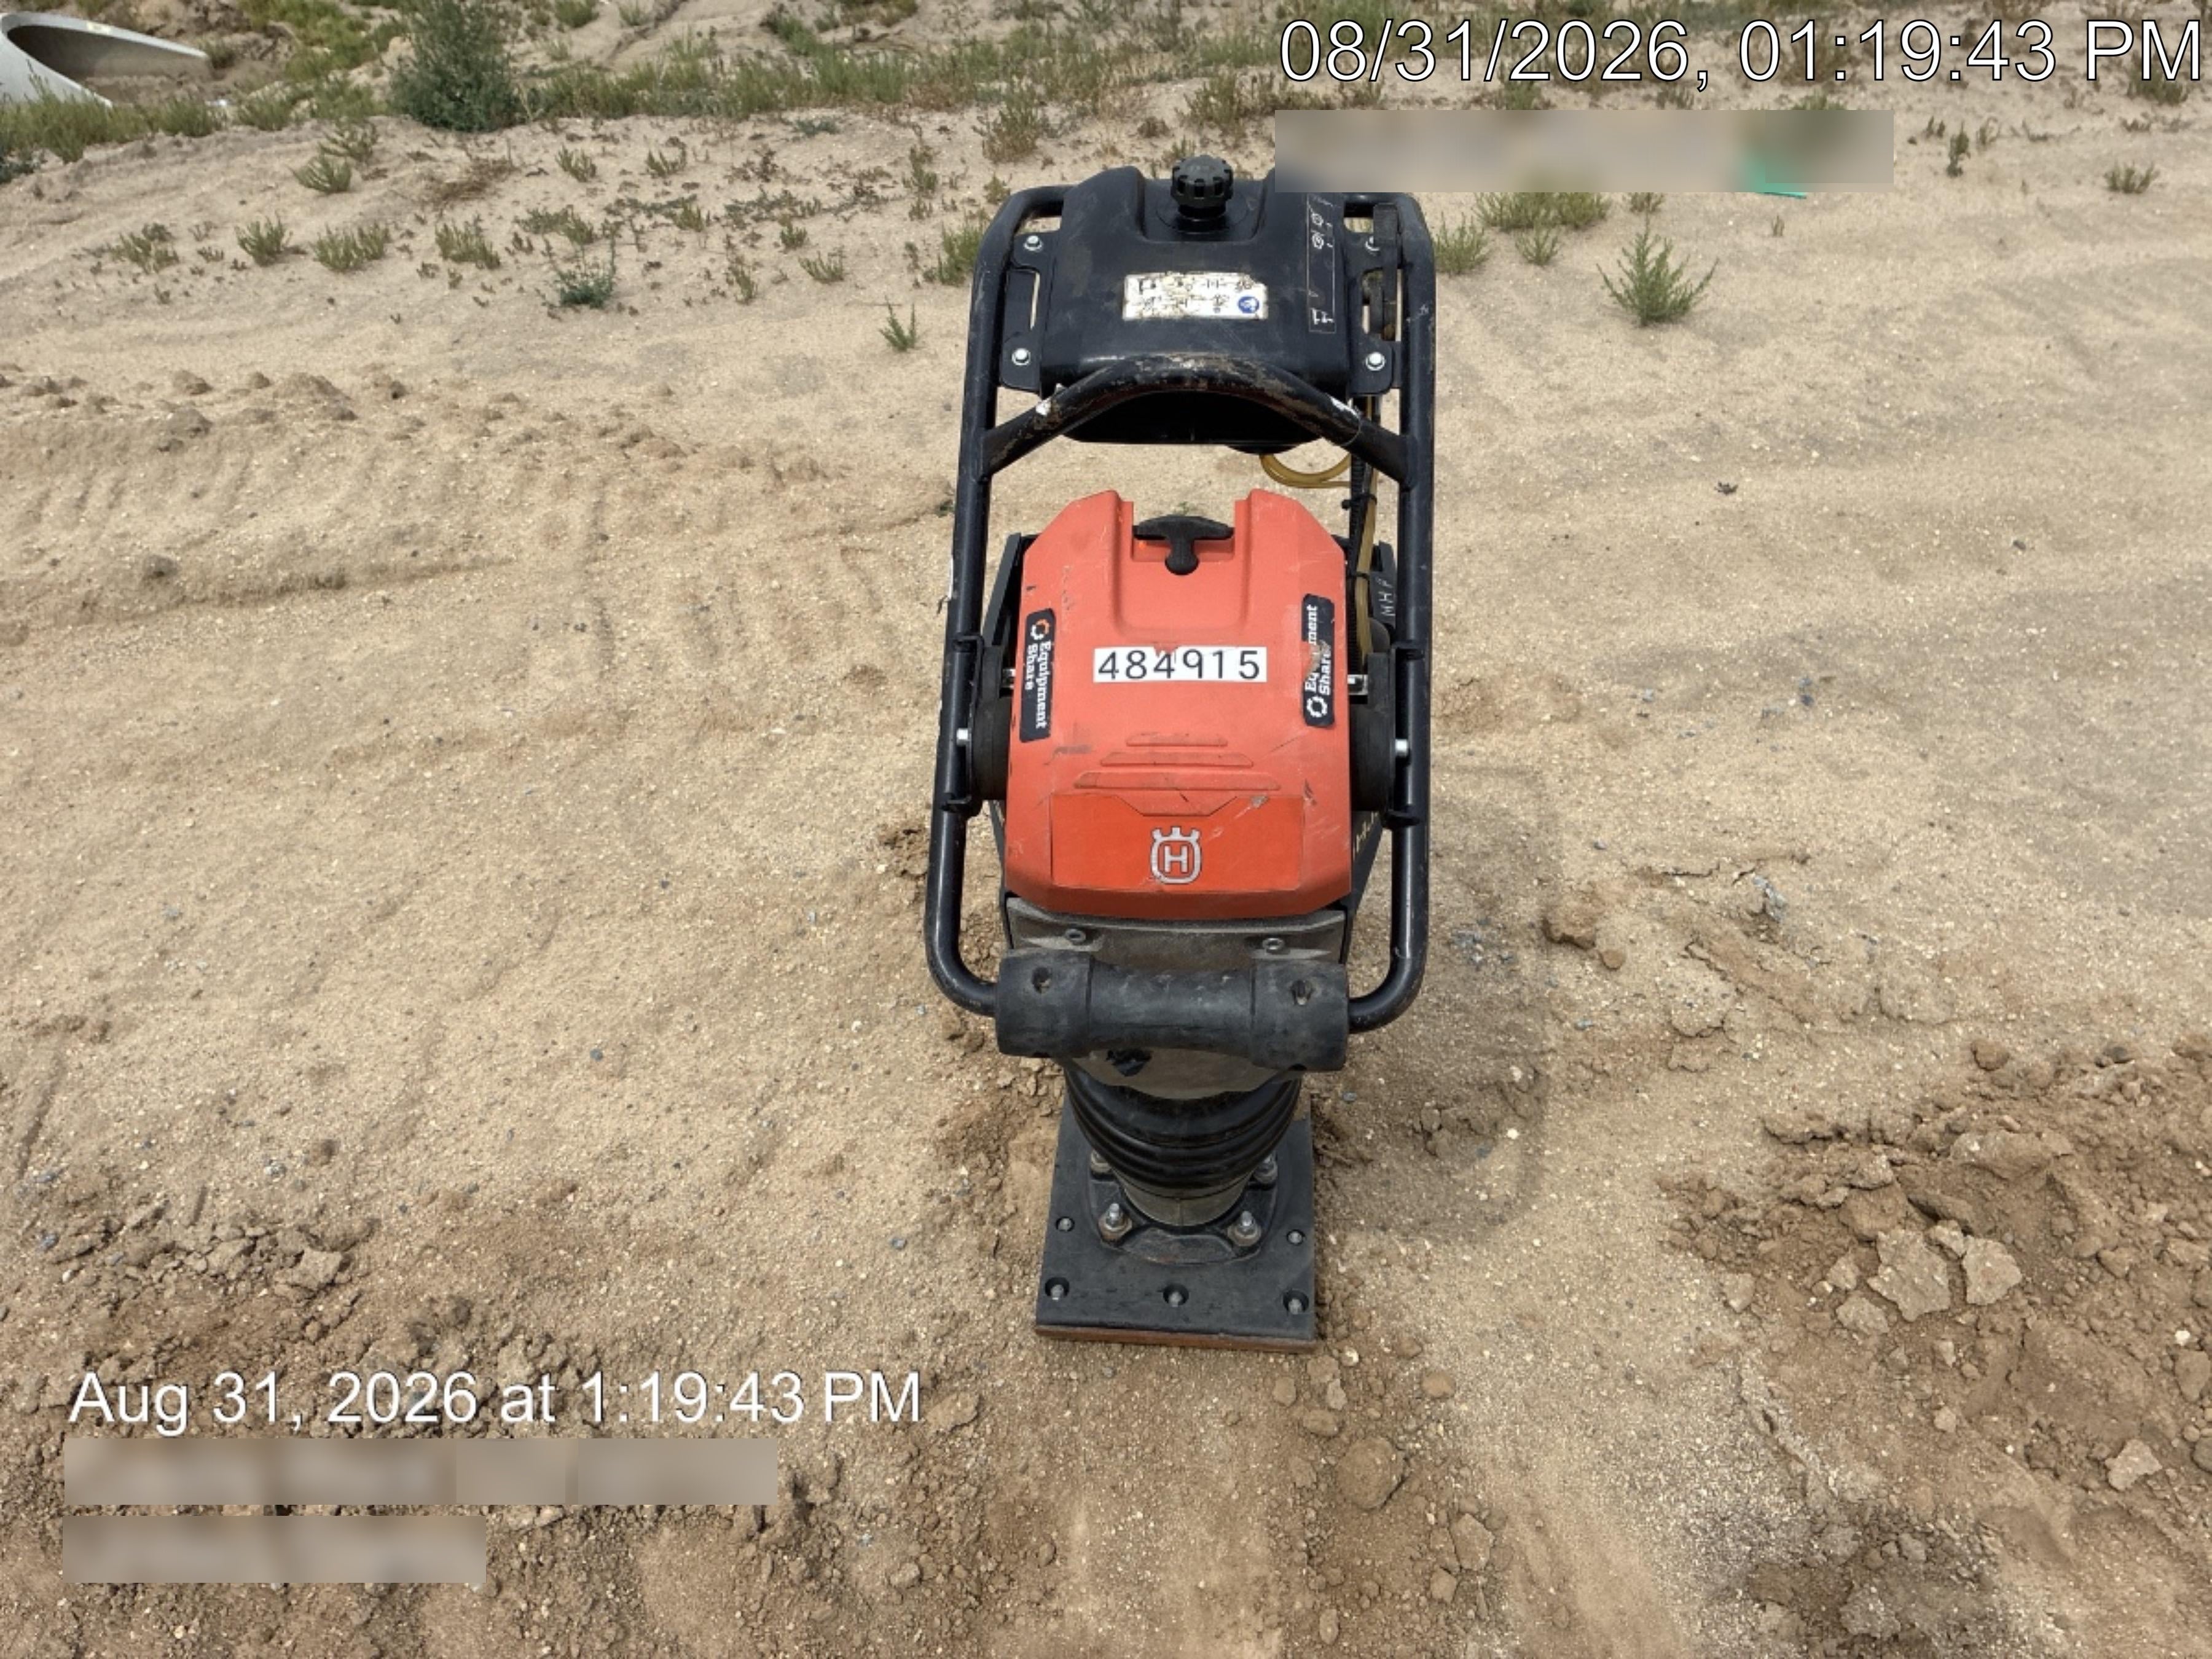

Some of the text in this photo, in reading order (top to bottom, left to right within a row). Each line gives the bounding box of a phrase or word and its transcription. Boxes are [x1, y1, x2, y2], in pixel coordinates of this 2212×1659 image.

[1024, 643, 1038, 690] Share
[1097, 648, 1260, 680] 484915
[1304, 604, 1320, 692] Eqment
[1036, 641, 1051, 729] Equipment
